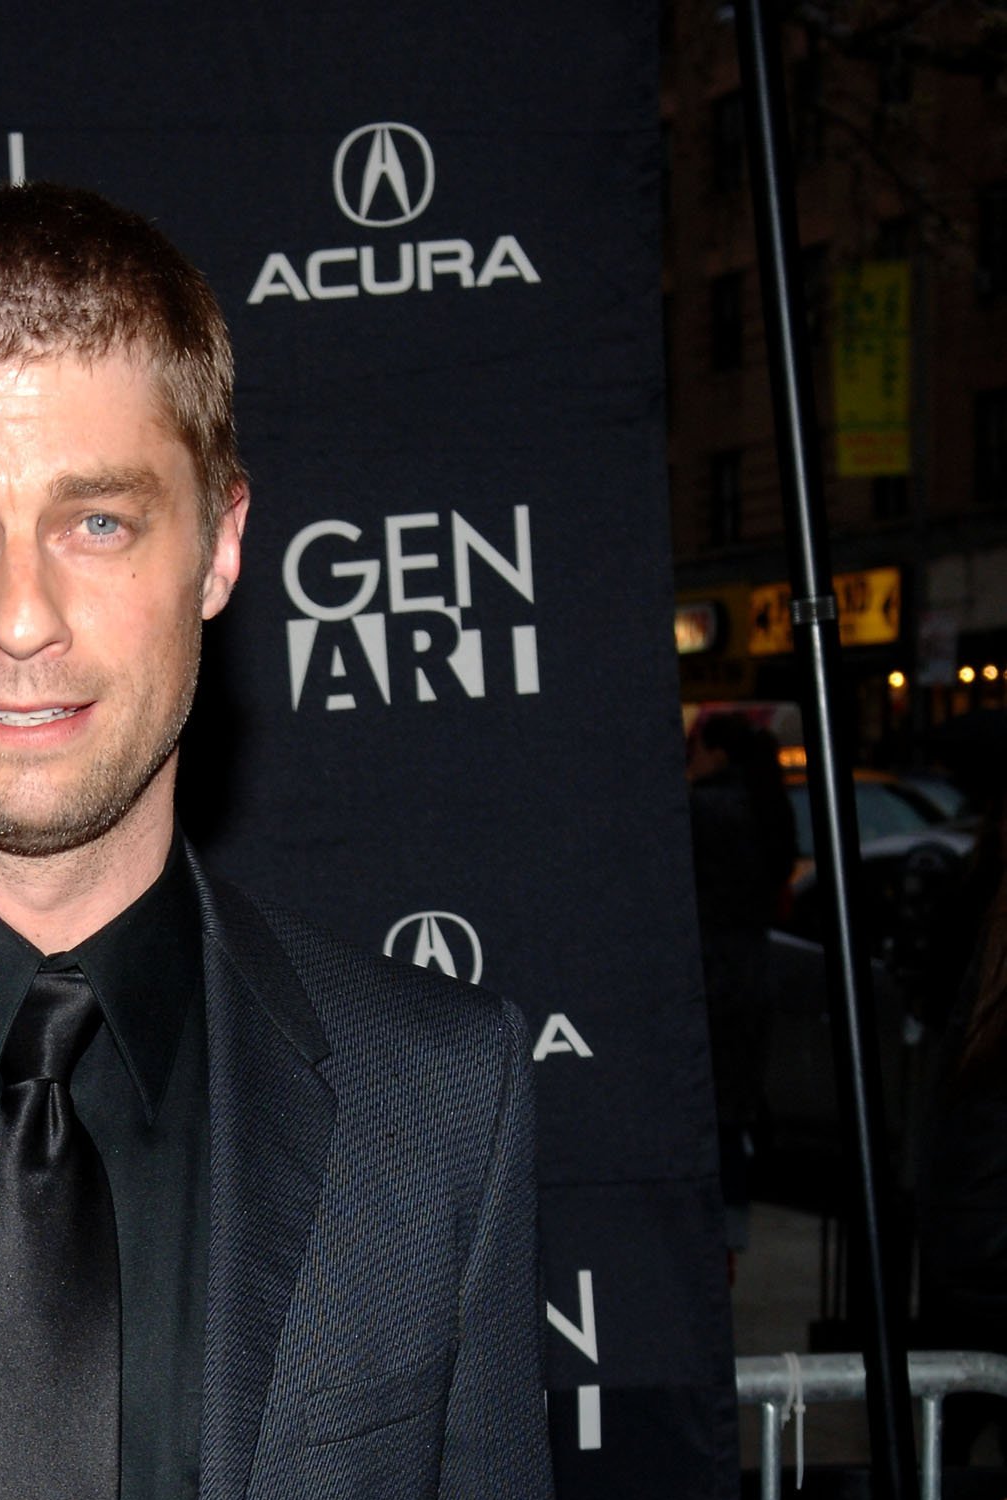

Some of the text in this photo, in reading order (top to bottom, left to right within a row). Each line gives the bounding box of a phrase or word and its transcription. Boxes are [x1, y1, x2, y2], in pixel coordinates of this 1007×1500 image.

[247, 235, 541, 304] ACURA
[282, 503, 534, 622] GEN
[287, 607, 540, 712] ART
